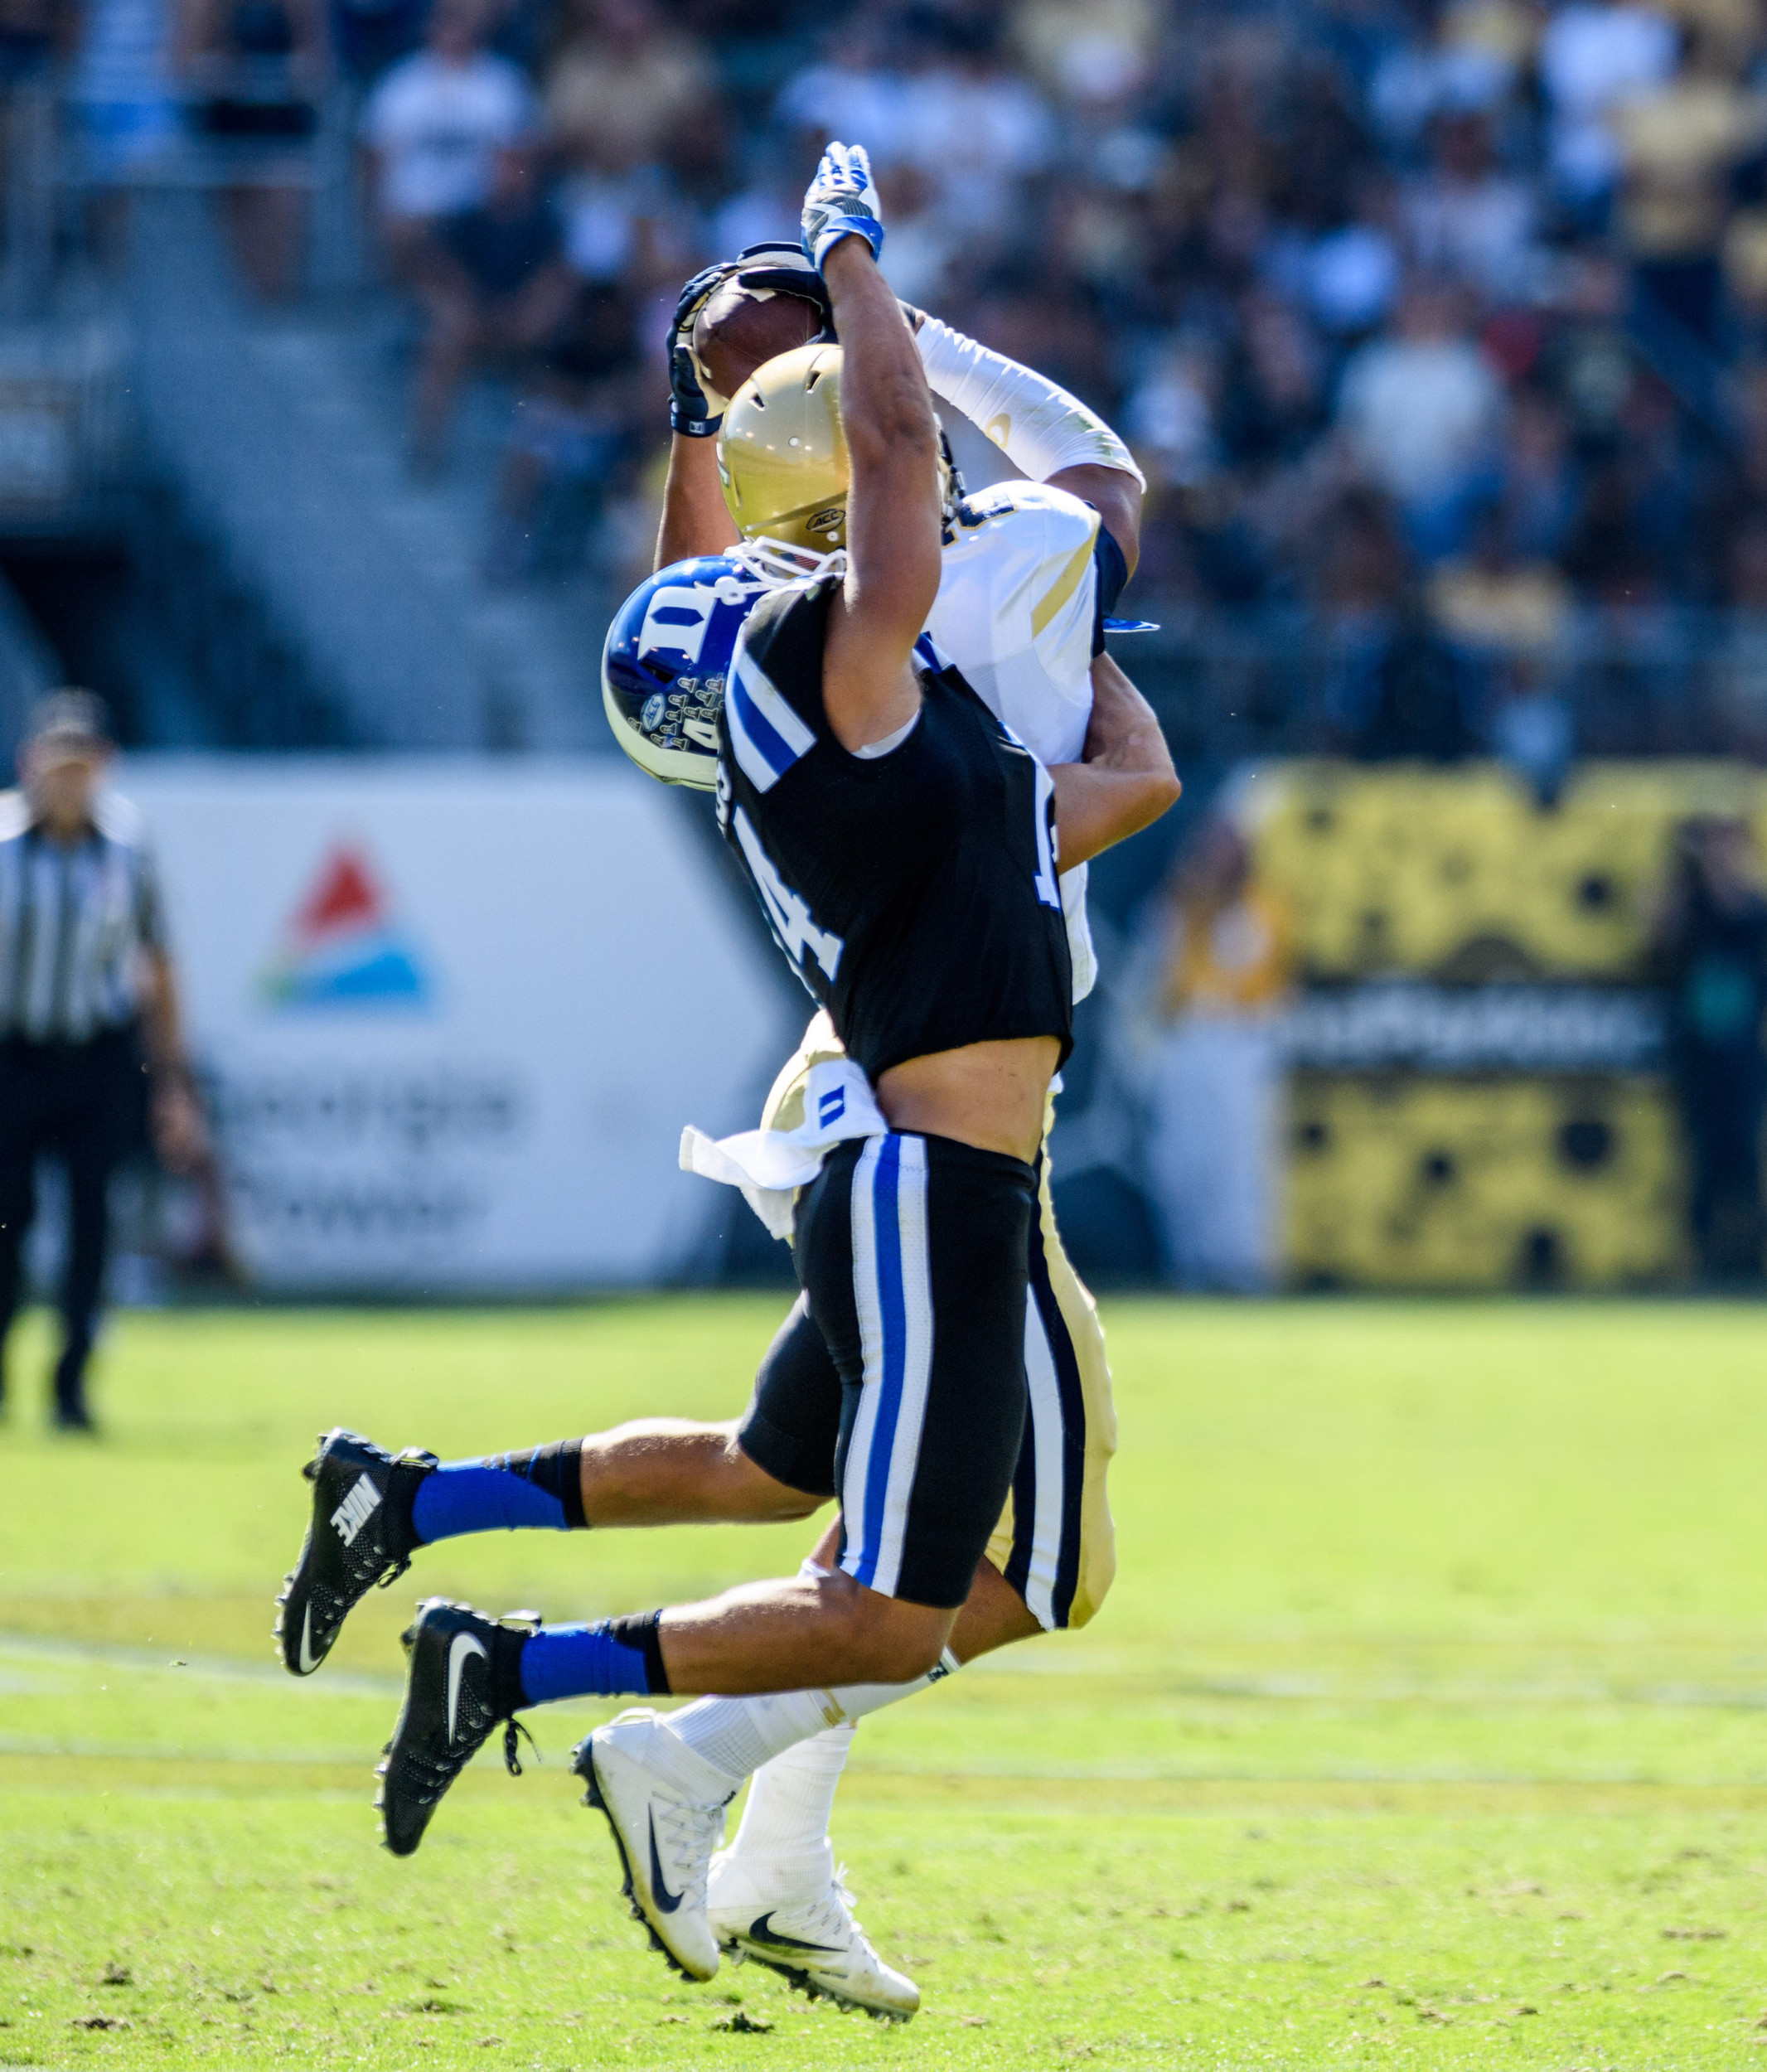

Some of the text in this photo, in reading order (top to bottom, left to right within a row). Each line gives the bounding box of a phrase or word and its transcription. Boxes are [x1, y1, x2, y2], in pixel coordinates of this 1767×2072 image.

[812, 511, 840, 528] ACC
[733, 802, 844, 981] 4
[1034, 759, 1066, 911] 1
[329, 1472, 381, 1548] NIKE
